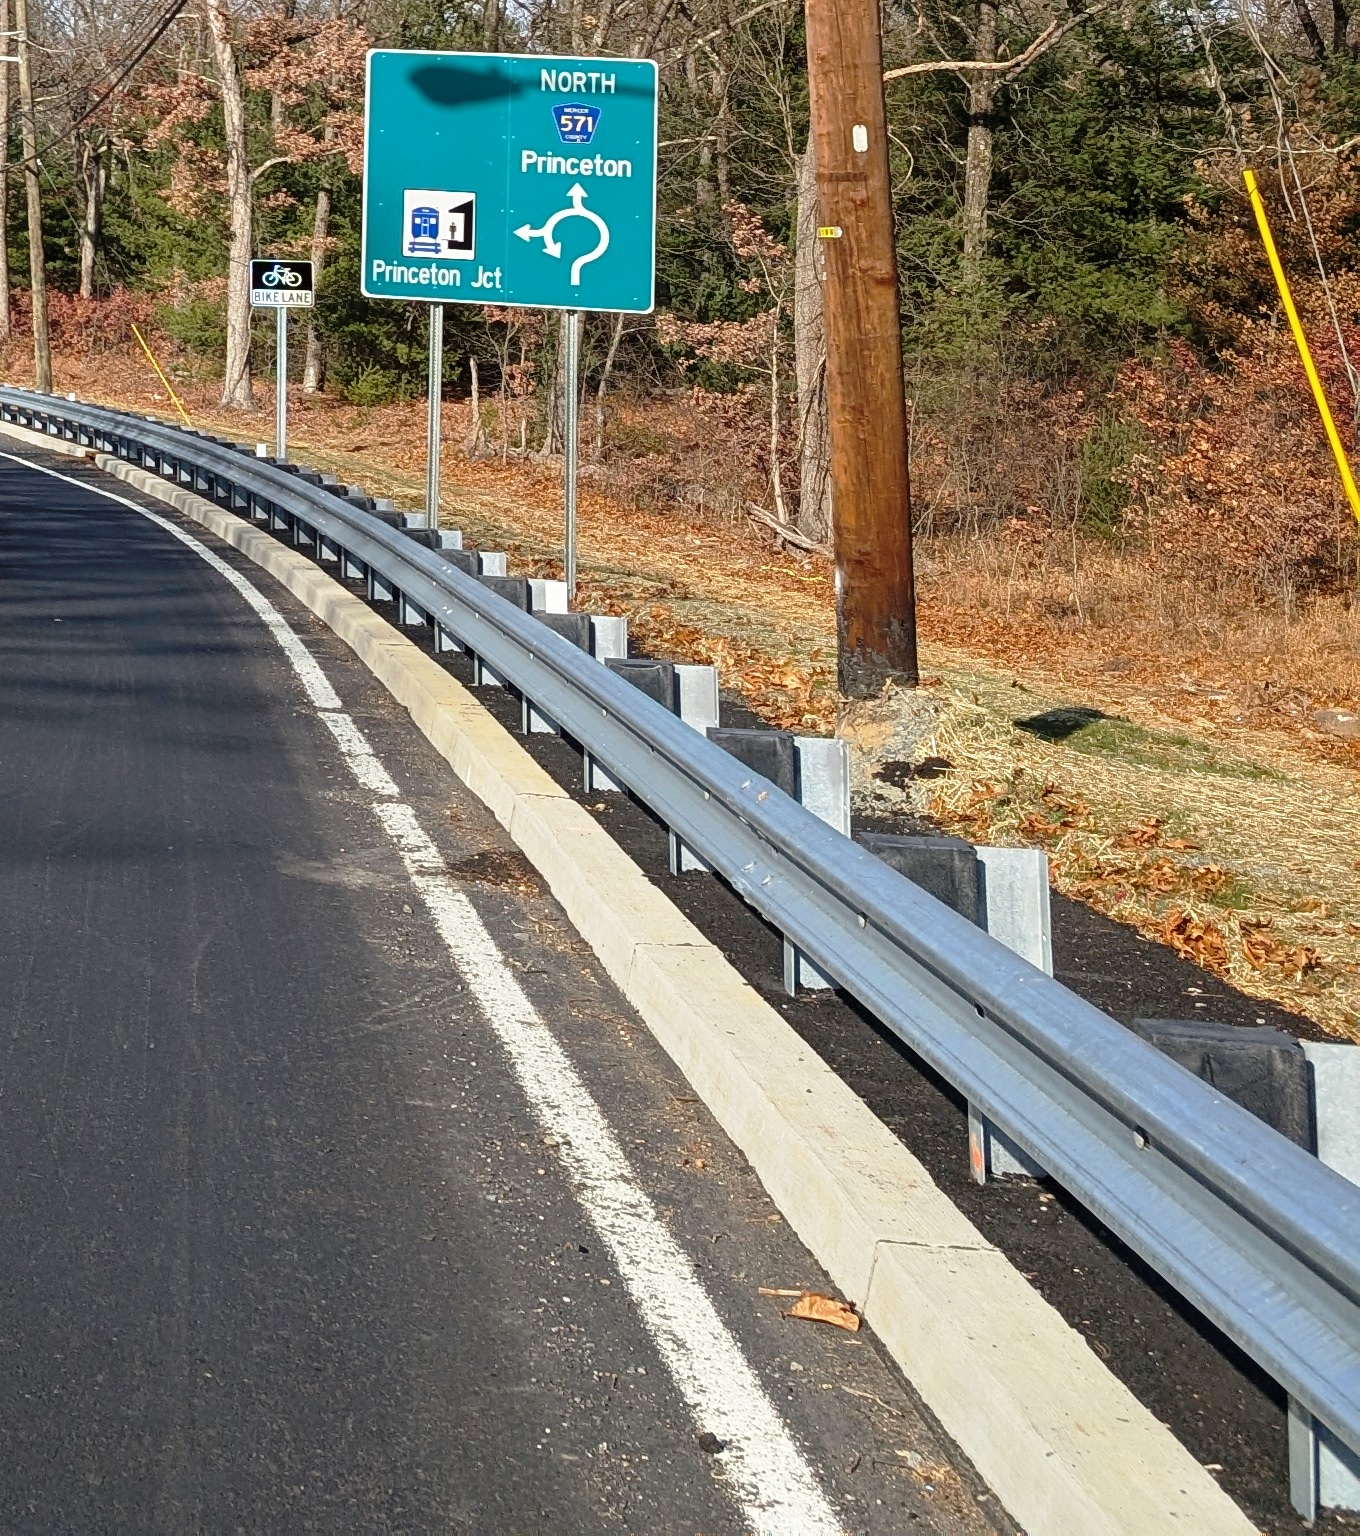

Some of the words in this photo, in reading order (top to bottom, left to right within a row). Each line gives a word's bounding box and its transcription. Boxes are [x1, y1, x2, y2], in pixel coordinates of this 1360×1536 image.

[541, 69, 616, 94] NORTH
[560, 115, 593, 133] 571
[521, 149, 632, 178] Princeton
[372, 259, 461, 287] Princeton
[471, 265, 503, 290] Jct
[254, 291, 280, 303] BIKE
[281, 292, 311, 304] LANE
